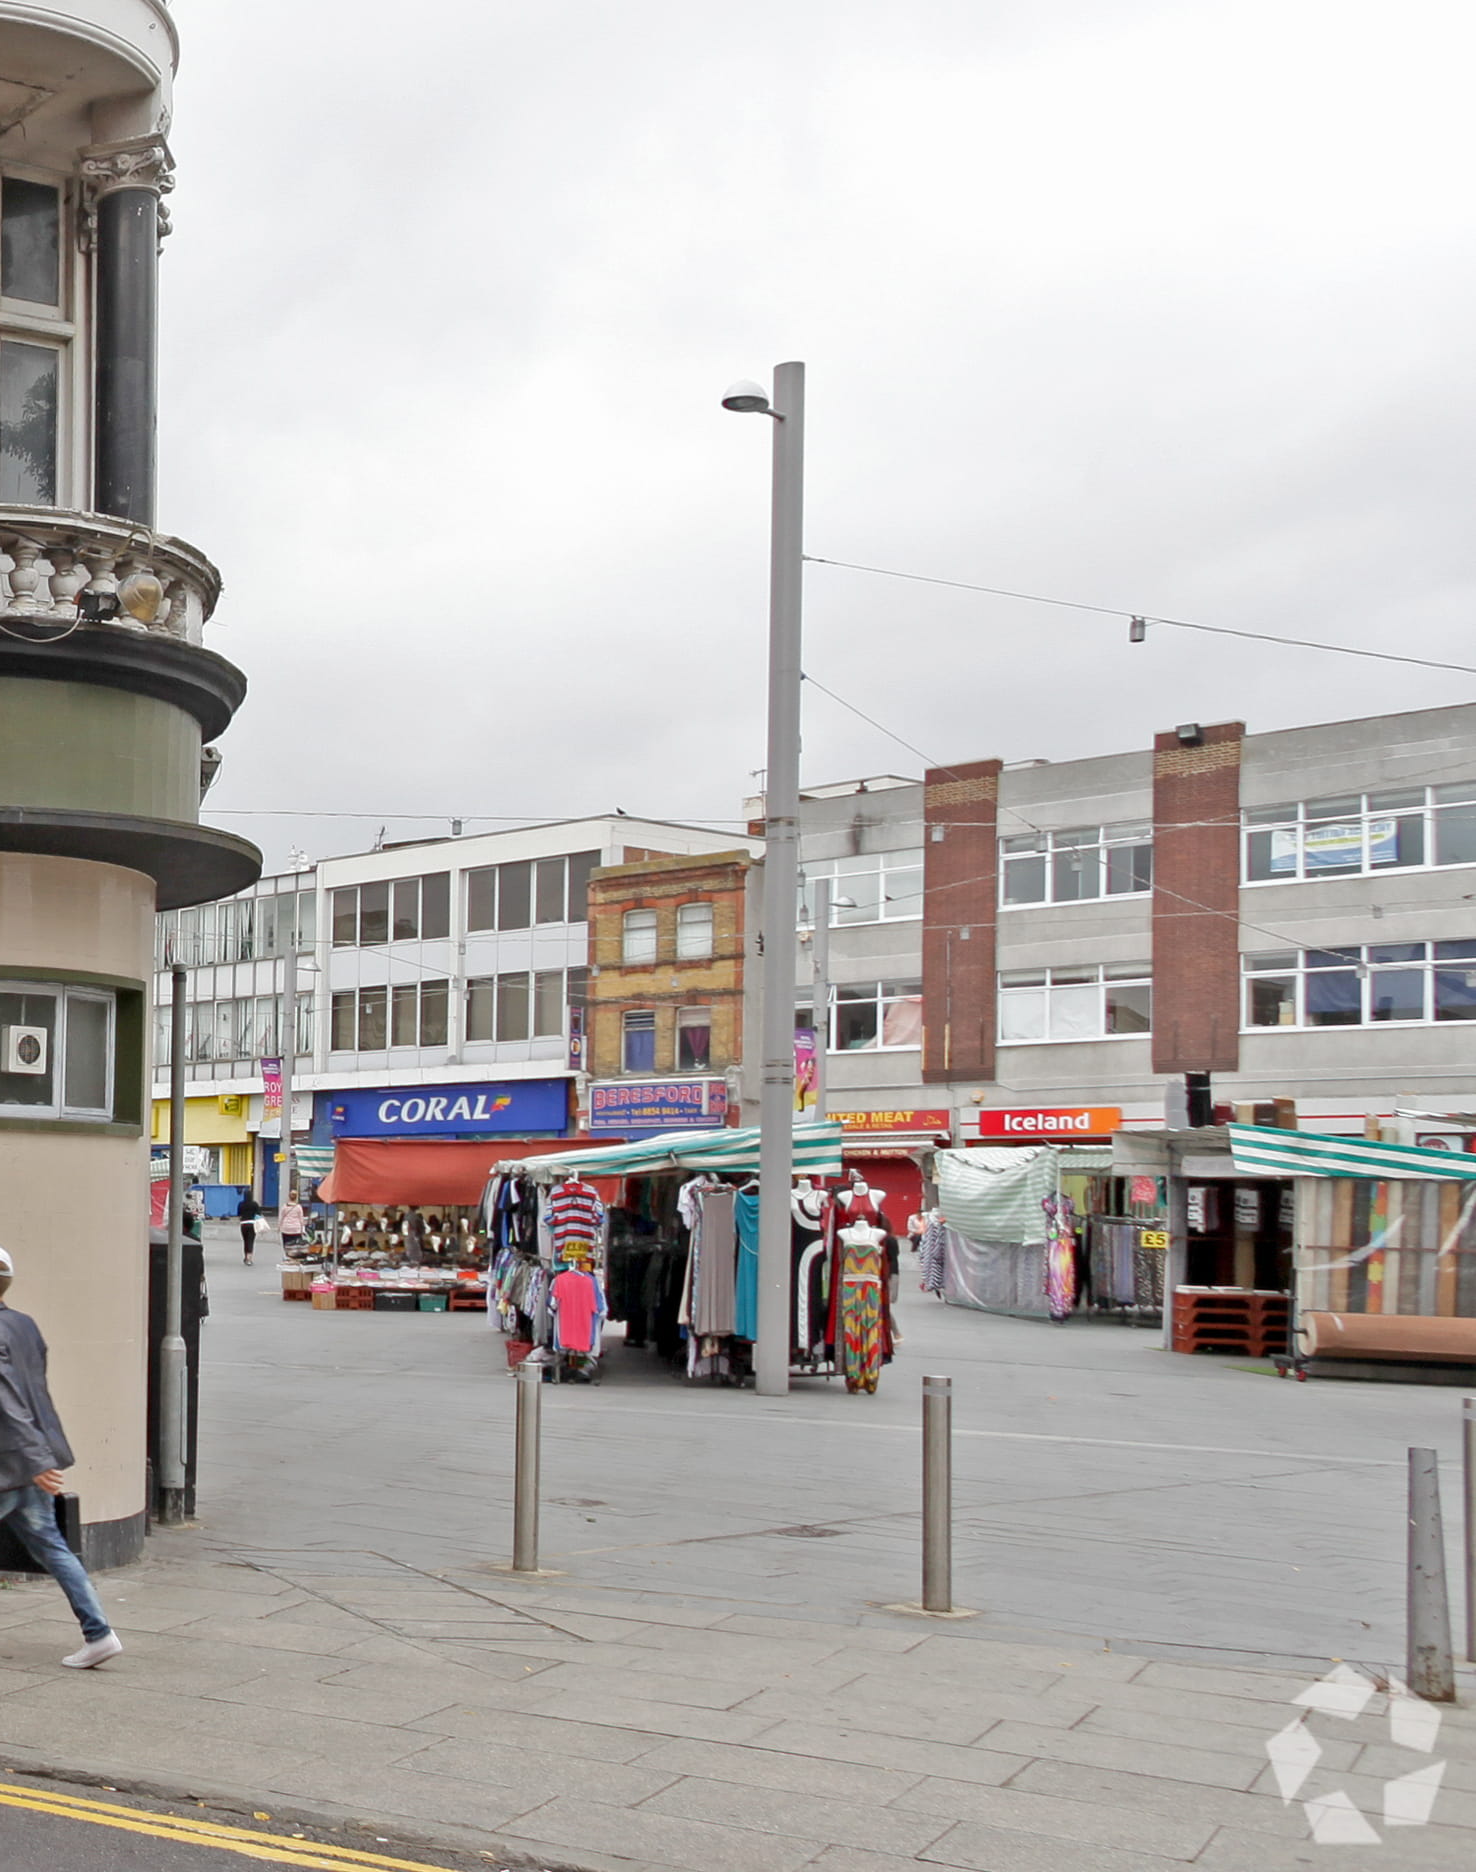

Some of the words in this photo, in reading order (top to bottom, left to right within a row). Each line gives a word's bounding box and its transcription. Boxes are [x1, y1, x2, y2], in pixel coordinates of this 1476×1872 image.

[264, 1081, 282, 1093] ROY
[264, 1095, 282, 1107] GRE
[594, 1085, 703, 1109] BERESFORD
[378, 1095, 491, 1123] CORAL
[825, 1112, 866, 1124] ITED
[871, 1111, 914, 1122] MEAT
[1004, 1112, 1089, 1131] Iceland
[1144, 1233, 1166, 1246] £5
